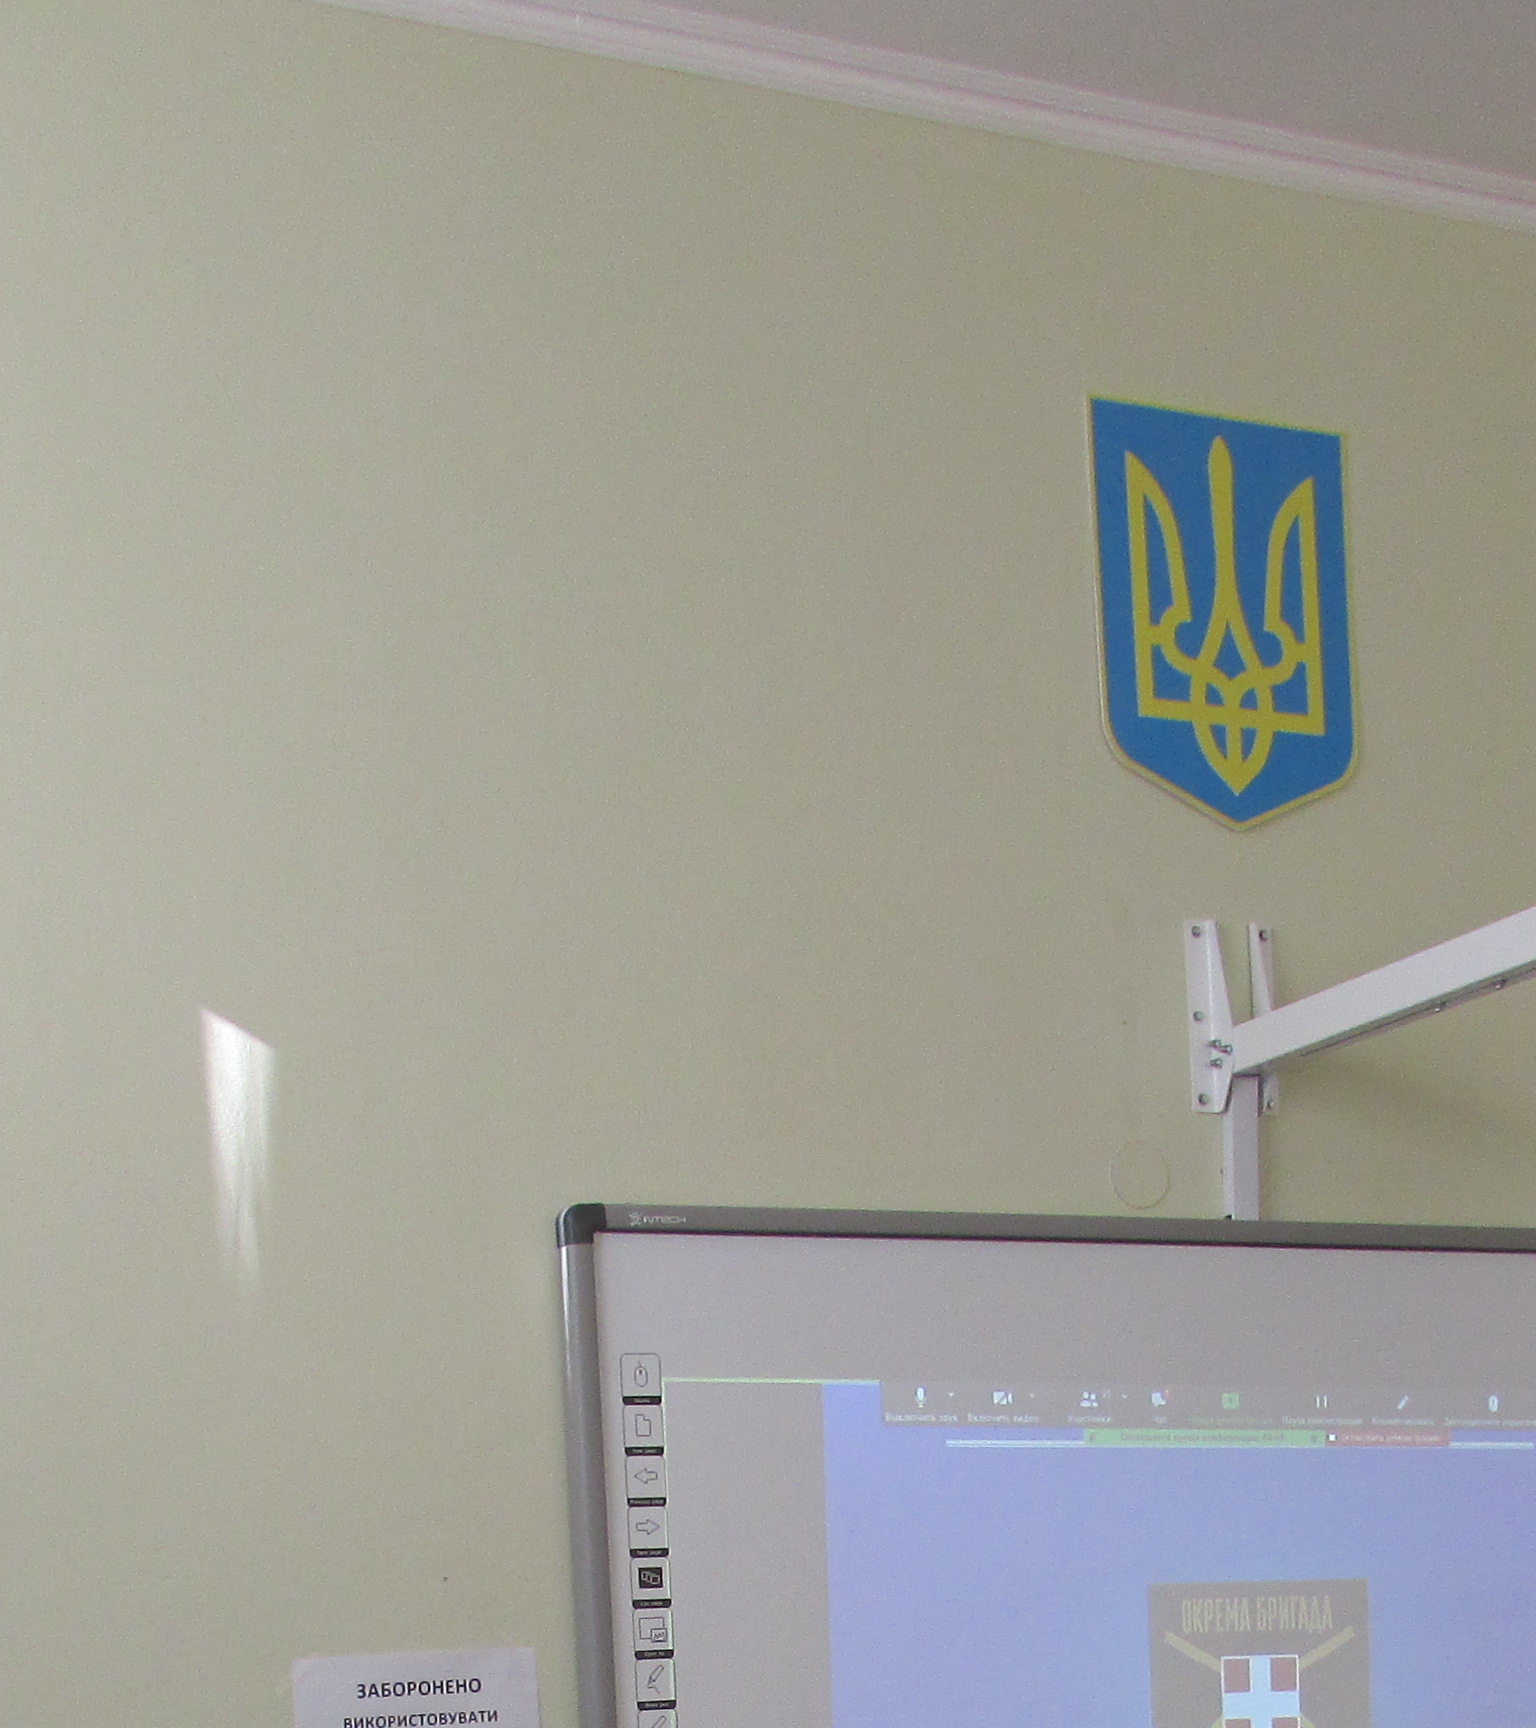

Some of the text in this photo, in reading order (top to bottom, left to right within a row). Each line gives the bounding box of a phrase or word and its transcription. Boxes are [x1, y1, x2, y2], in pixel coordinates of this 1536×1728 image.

[1181, 1595, 1334, 1633] ОКРЕМА БРИГАДА
[356, 1677, 482, 1699] ЗАБОРОНЕНО
